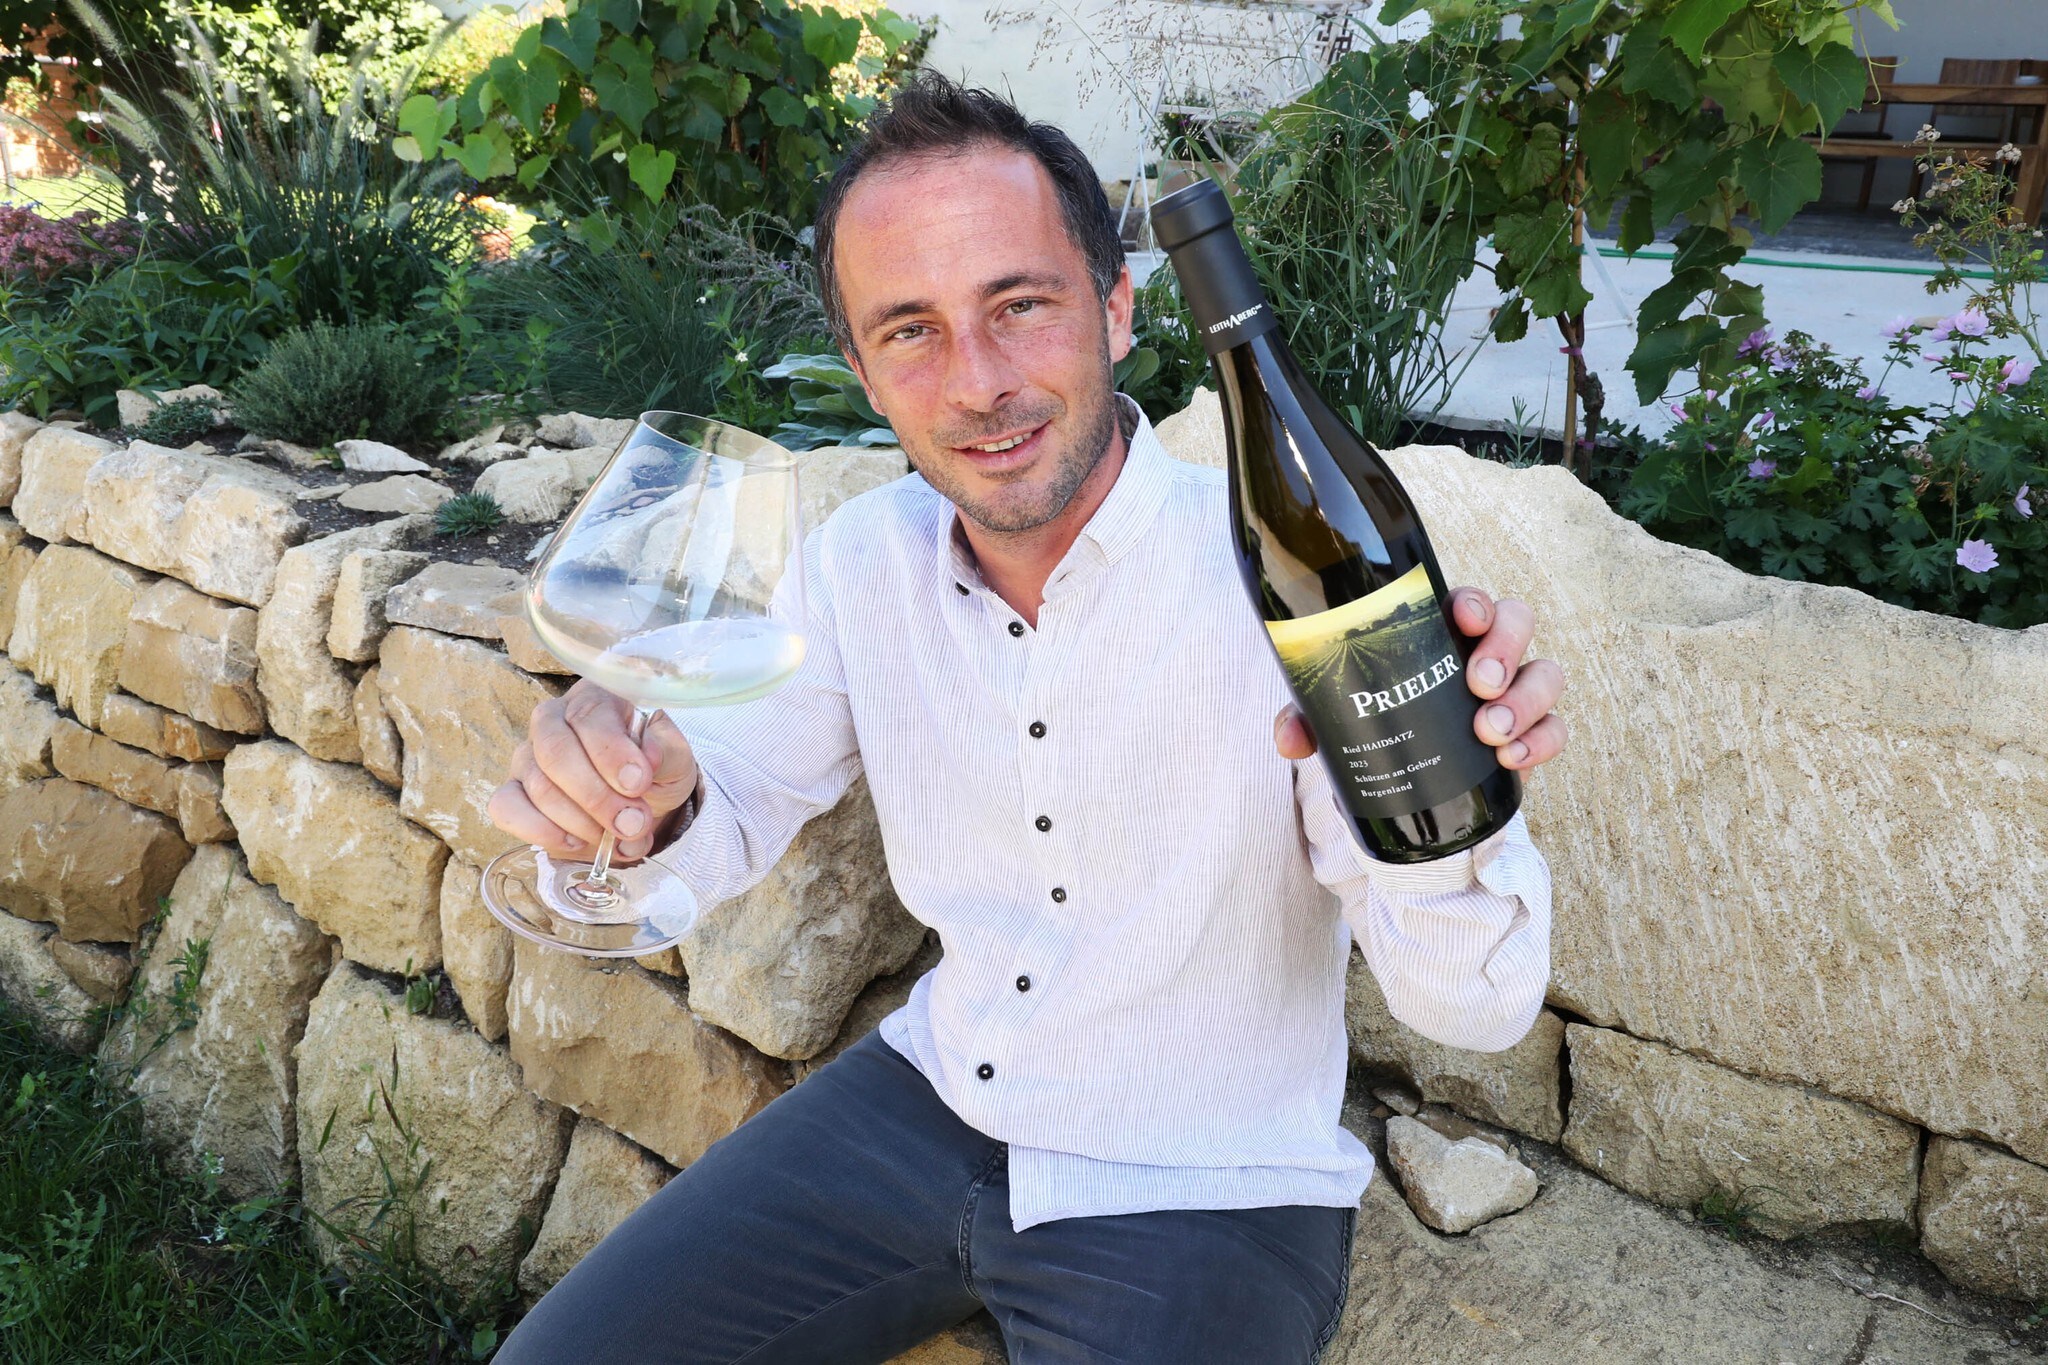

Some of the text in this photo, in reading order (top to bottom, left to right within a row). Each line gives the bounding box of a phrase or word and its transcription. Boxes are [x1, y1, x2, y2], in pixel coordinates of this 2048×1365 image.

[1349, 654, 1460, 718] PRIELER
[1342, 730, 1415, 754] Ried HAIDSATZ
[1349, 760, 1368, 769] 2023
[1354, 755, 1442, 783] Schützen am Gebirge
[1361, 781, 1413, 798] Burgenland
